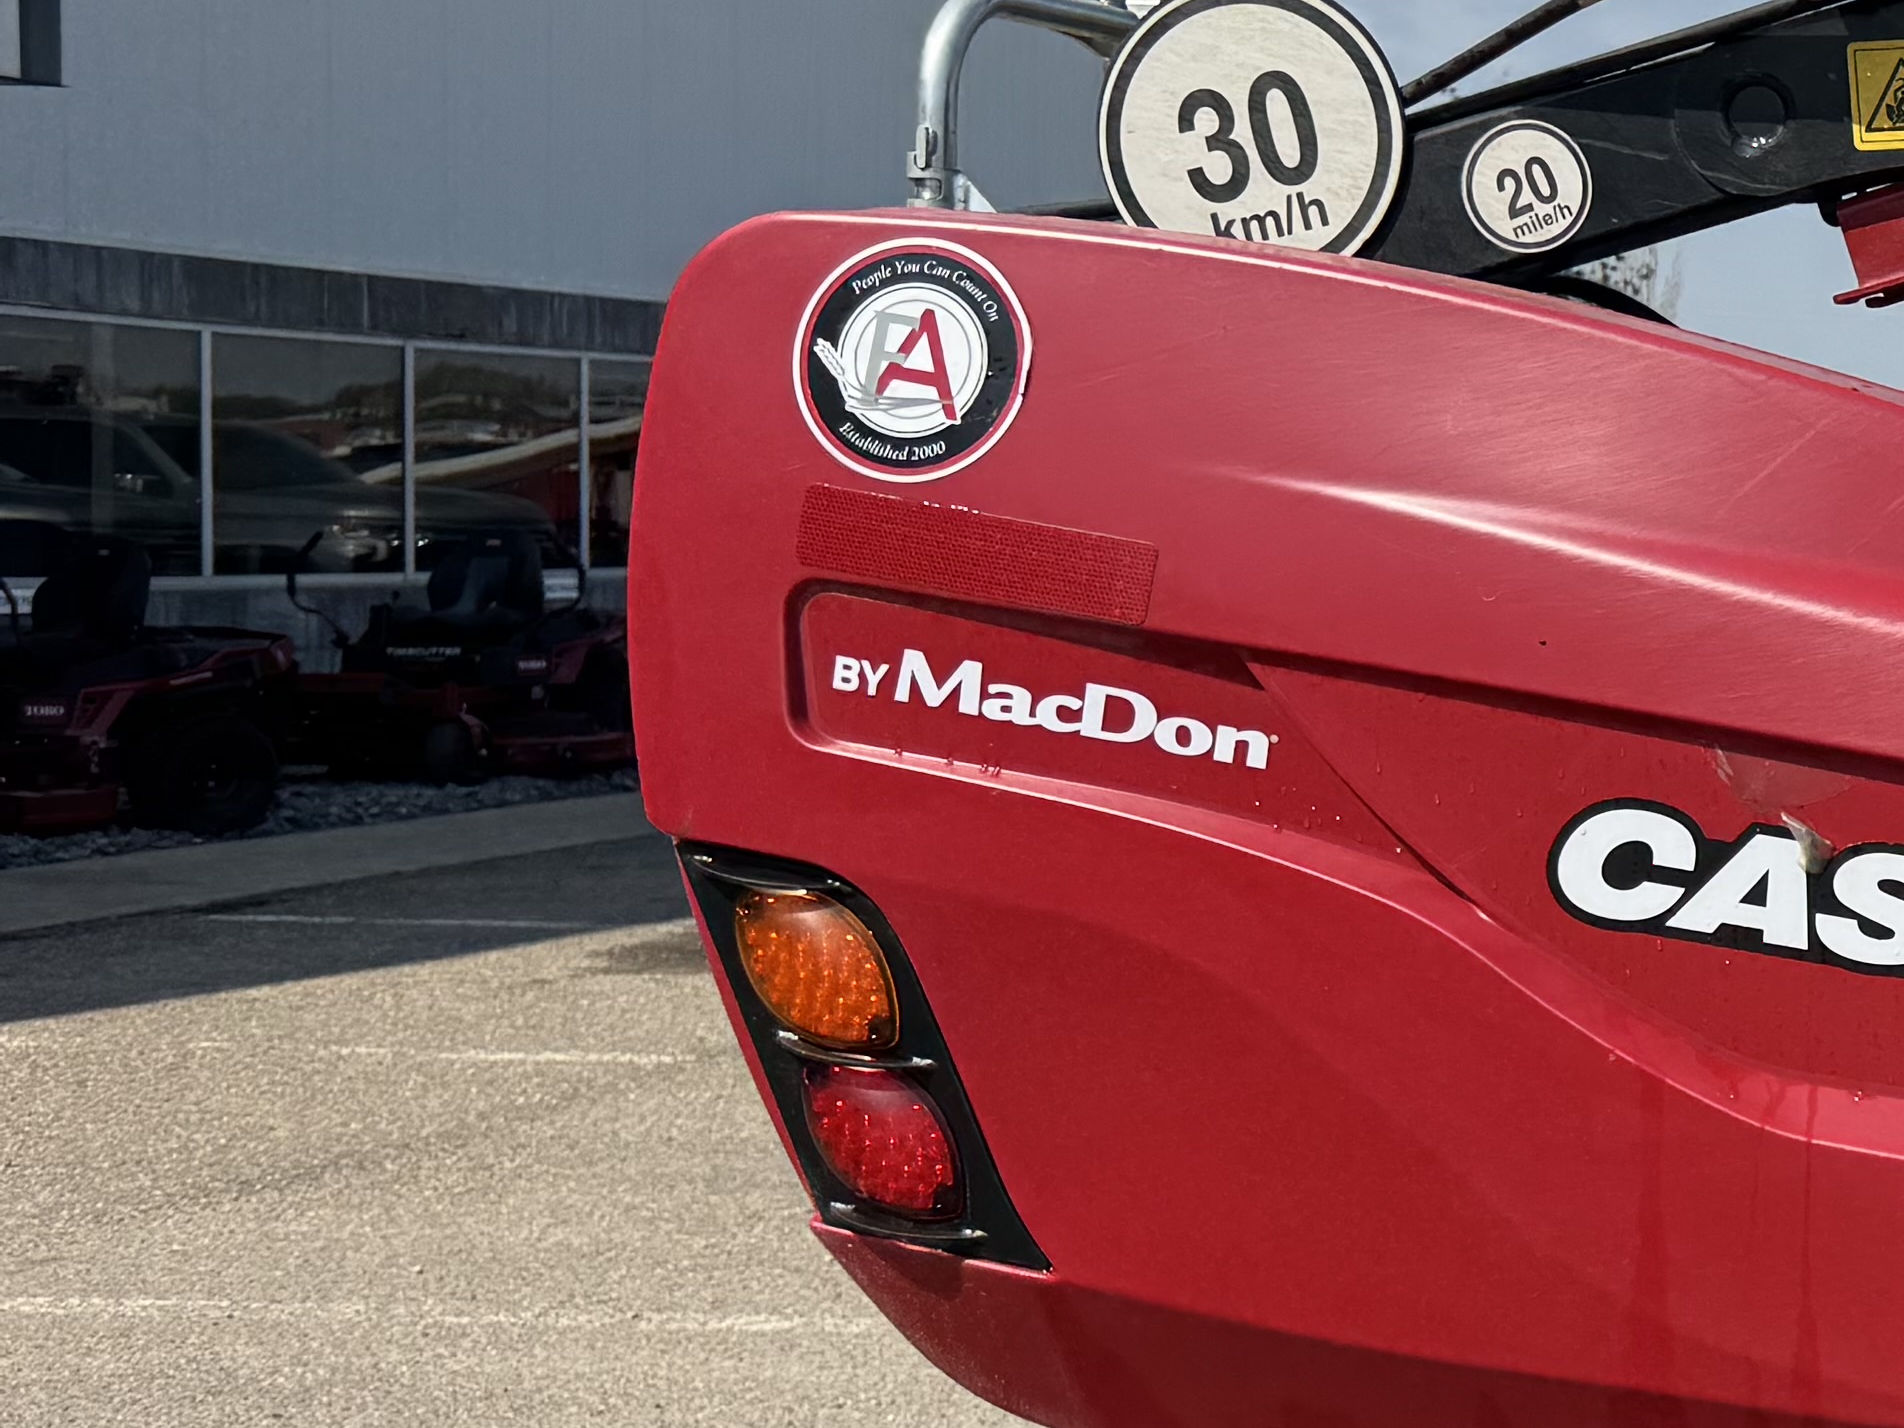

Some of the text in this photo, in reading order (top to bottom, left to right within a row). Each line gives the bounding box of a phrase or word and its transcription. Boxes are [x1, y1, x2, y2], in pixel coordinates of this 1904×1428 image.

[1177, 70, 1320, 204] 30
[1209, 191, 1330, 242] km/h
[1496, 156, 1558, 221] 20
[1512, 202, 1573, 239] mile/h
[851, 260, 999, 322] People You Can Count On
[838, 422, 946, 461] Established 2000
[832, 648, 1272, 770] BY MacDon
